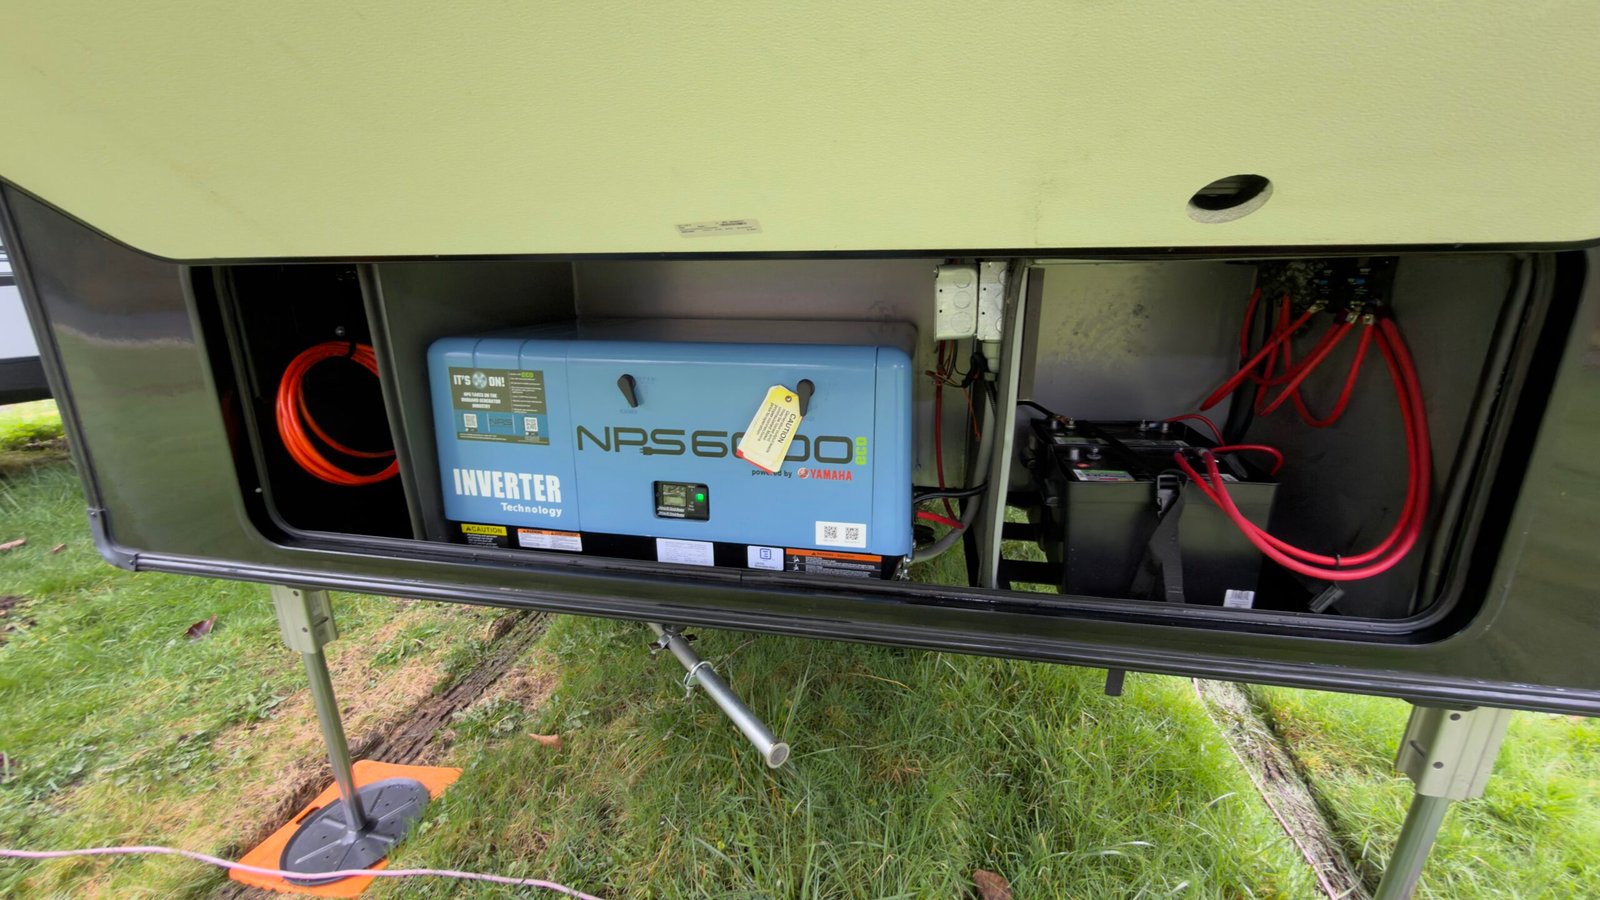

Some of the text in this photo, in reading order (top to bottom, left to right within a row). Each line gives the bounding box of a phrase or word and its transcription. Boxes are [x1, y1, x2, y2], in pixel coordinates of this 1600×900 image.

[454, 374, 506, 387] IT'S ON!
[777, 413, 796, 443] CAUTION
[855, 436, 867, 465] eco
[784, 470, 792, 478] by
[810, 468, 852, 480] YAMAHA
[453, 468, 561, 503] INVERTER
[501, 502, 562, 517] Technology
